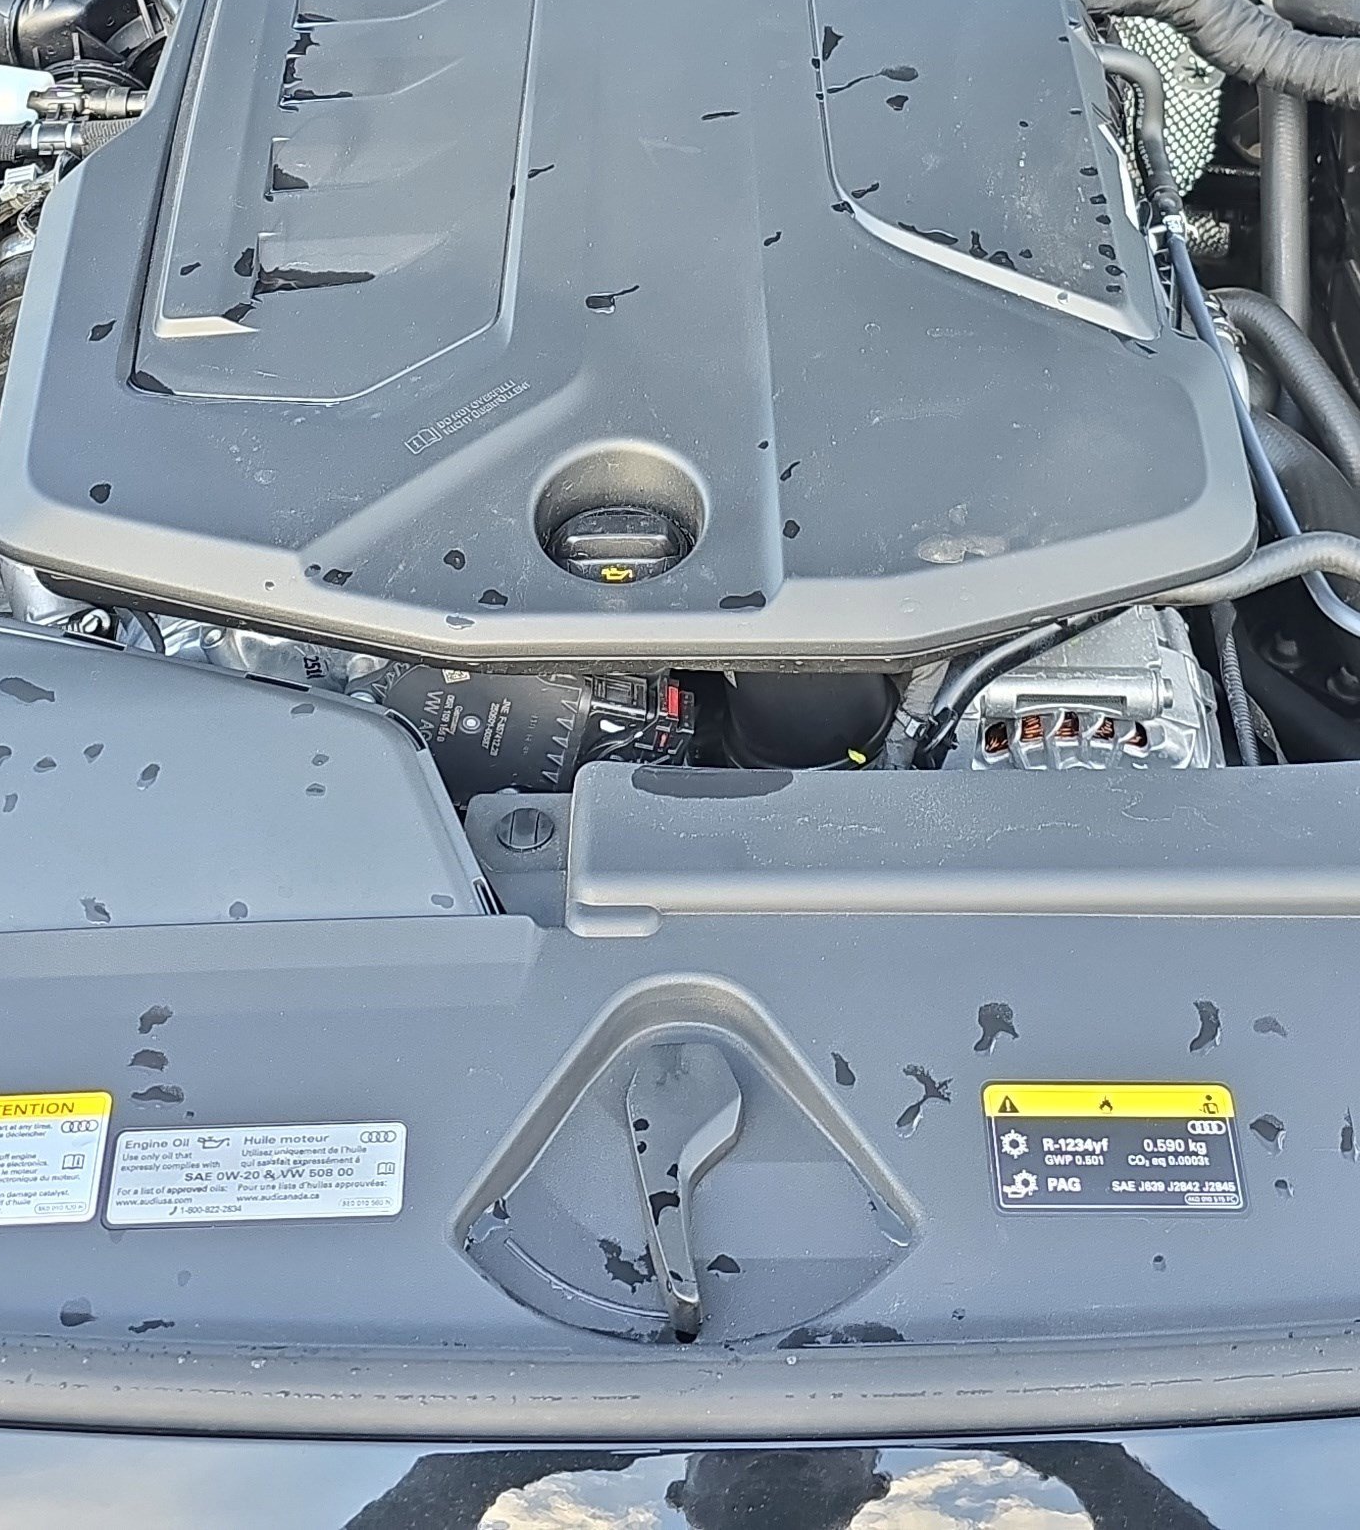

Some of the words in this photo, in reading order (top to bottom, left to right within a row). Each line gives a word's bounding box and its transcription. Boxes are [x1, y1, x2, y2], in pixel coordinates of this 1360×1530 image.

[436, 417, 452, 429] DO
[423, 691, 444, 715] VW
[18, 1124, 33, 1132] any
[125, 1139, 168, 1150] Engine
[172, 1138, 189, 1148] Oil
[243, 1135, 276, 1145] Huile
[280, 1135, 330, 1144] moteur
[1042, 1137, 1109, 1154] R-1234yf
[1143, 1138, 1184, 1152] 0.590
[1188, 1139, 1207, 1155] kg
[11, 1153, 37, 1161] engine
[122, 1153, 139, 1161] Use
[141, 1153, 160, 1161] only
[274, 1148, 326, 1157] uniquement
[241, 1159, 255, 1168] qui
[257, 1158, 290, 1167] satisfait
[292, 1156, 353, 1166] expressément
[1044, 1154, 1073, 1166] GWP
[1075, 1155, 1105, 1166] 0.501
[1152, 1157, 1166, 1168] eq
[120, 1164, 160, 1172] expressly
[162, 1162, 200, 1170] complies
[185, 1172, 213, 1181] SAE
[216, 1171, 260, 1181] 0W-20
[264, 1170, 275, 1179] &
[280, 1169, 304, 1178] VW
[309, 1168, 333, 1177] 508
[337, 1167, 354, 1177] 00
[237, 1183, 257, 1191] Pour
[260, 1183, 275, 1191] une
[278, 1181, 296, 1190] liste
[1047, 1177, 1082, 1192] PAG
[1111, 1181, 1136, 1192] SAE
[1167, 1181, 1200, 1192] J2842
[1202, 1181, 1236, 1192] J2845
[6, 1191, 37, 1199] damage
[117, 1188, 131, 1196] For
[140, 1187, 154, 1195] list
[156, 1186, 165, 1194] of
[166, 1185, 207, 1195] approved
[116, 1197, 192, 1206] www.audiusa.com
[236, 1193, 320, 1202] www.audicanada.ca
